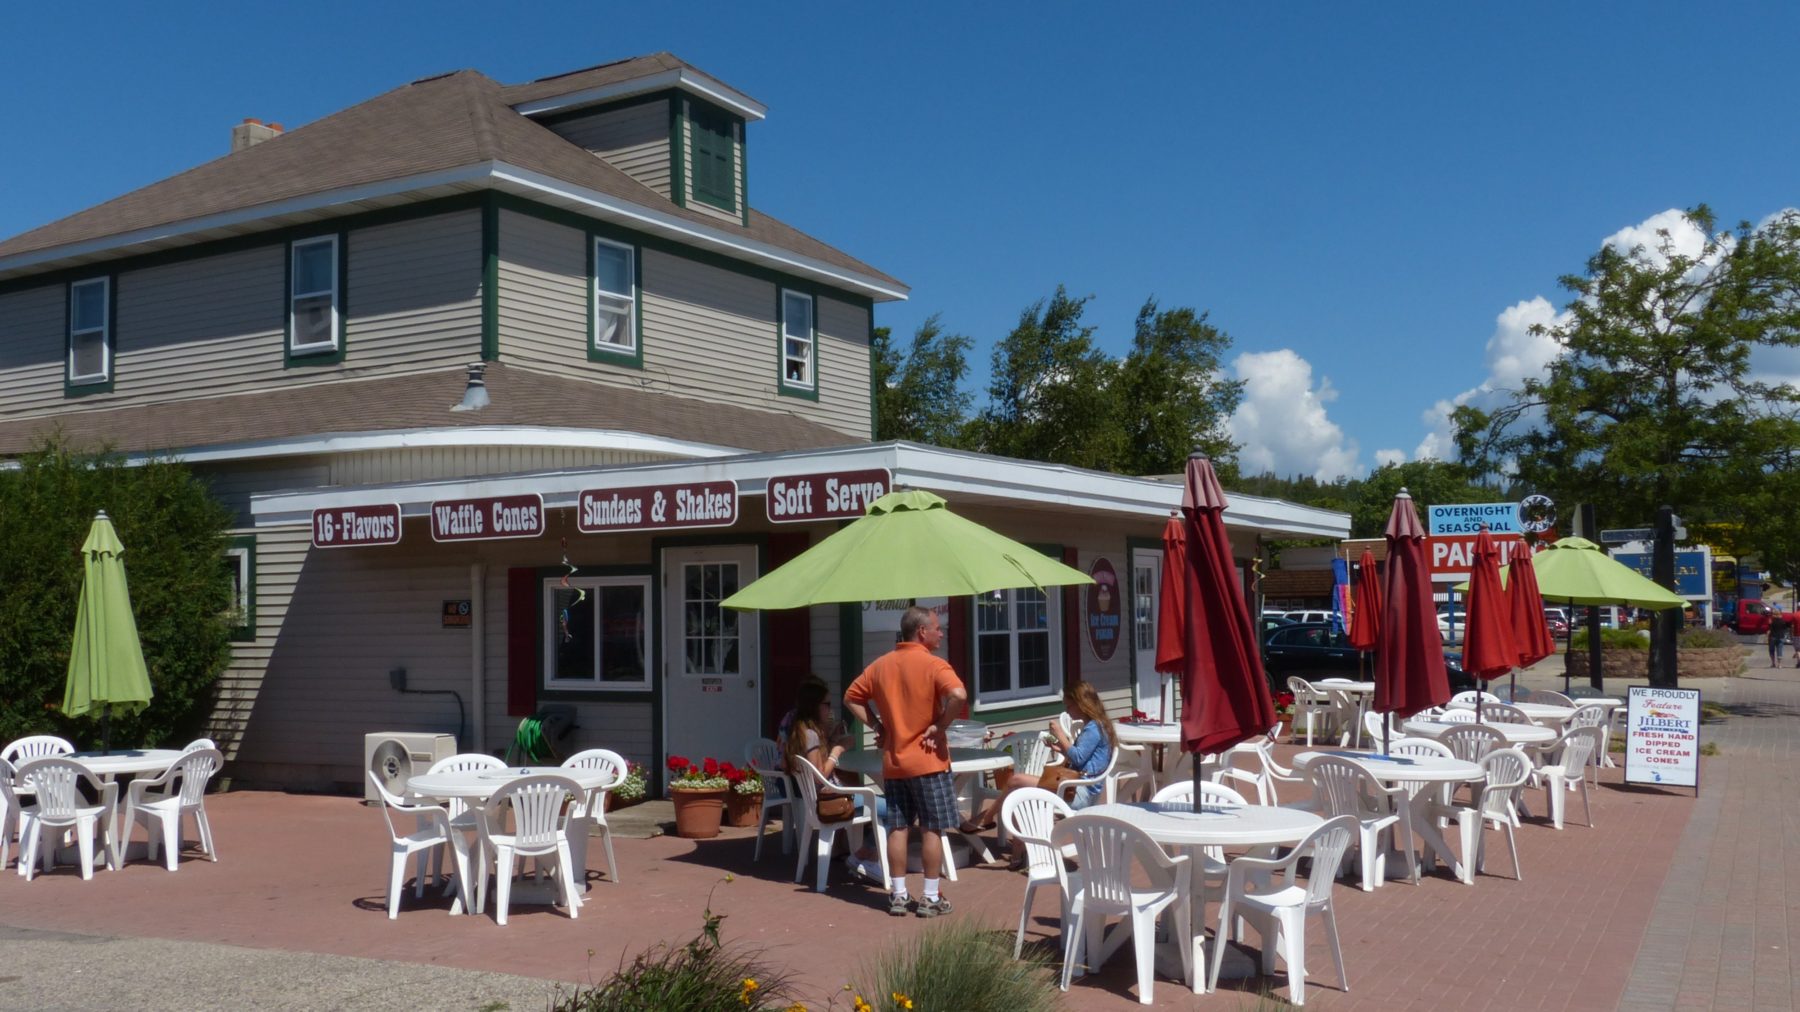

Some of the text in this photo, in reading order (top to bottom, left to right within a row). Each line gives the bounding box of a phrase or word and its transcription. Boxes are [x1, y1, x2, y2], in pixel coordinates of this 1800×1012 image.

[773, 478, 884, 516] Soft Serve
[584, 487, 731, 526] Sundaes & Shakes
[1435, 506, 1512, 517] OVERNIGHT
[435, 502, 538, 536] Waffle Cones
[317, 512, 395, 542] 16-Flavors
[1438, 522, 1511, 533] SEASONAL
[1632, 689, 1697, 700] WE PROUDLY
[1642, 699, 1683, 710] Feature
[1637, 716, 1692, 728] JILBERT
[1632, 731, 1695, 741] FRESH HAND
[1645, 740, 1681, 748] DIPPED
[1635, 747, 1691, 757] ICE CREAM
[1646, 756, 1680, 765] CONES
